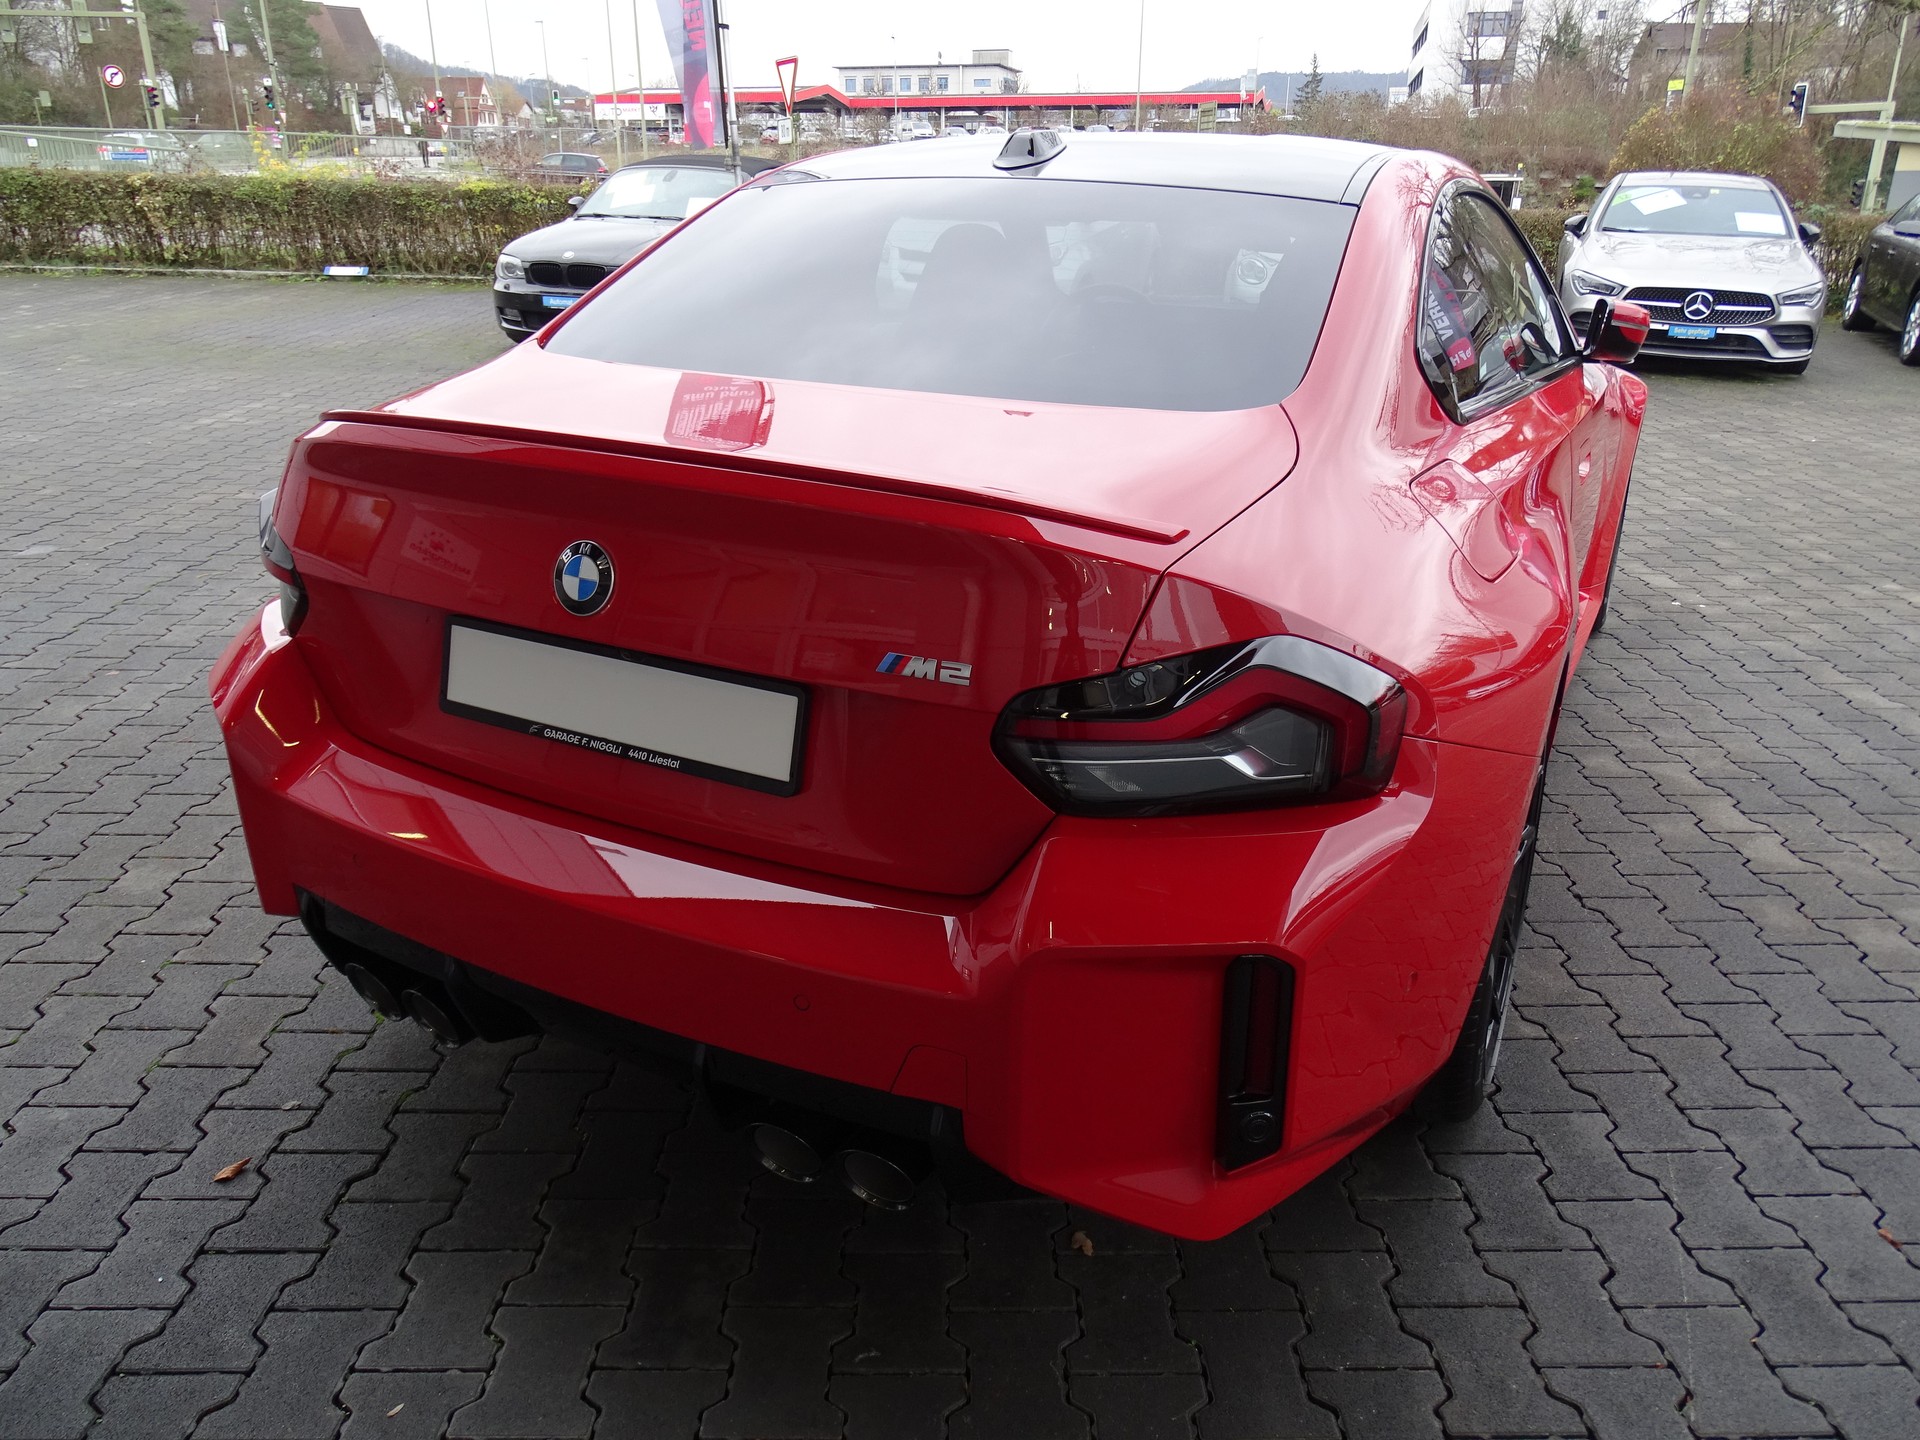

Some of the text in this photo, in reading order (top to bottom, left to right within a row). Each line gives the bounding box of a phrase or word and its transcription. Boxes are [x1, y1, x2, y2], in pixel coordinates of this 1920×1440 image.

[562, 542, 610, 569] BMW
[543, 728, 680, 769] GARAGE F. NIGGLI 4410 Liestal
